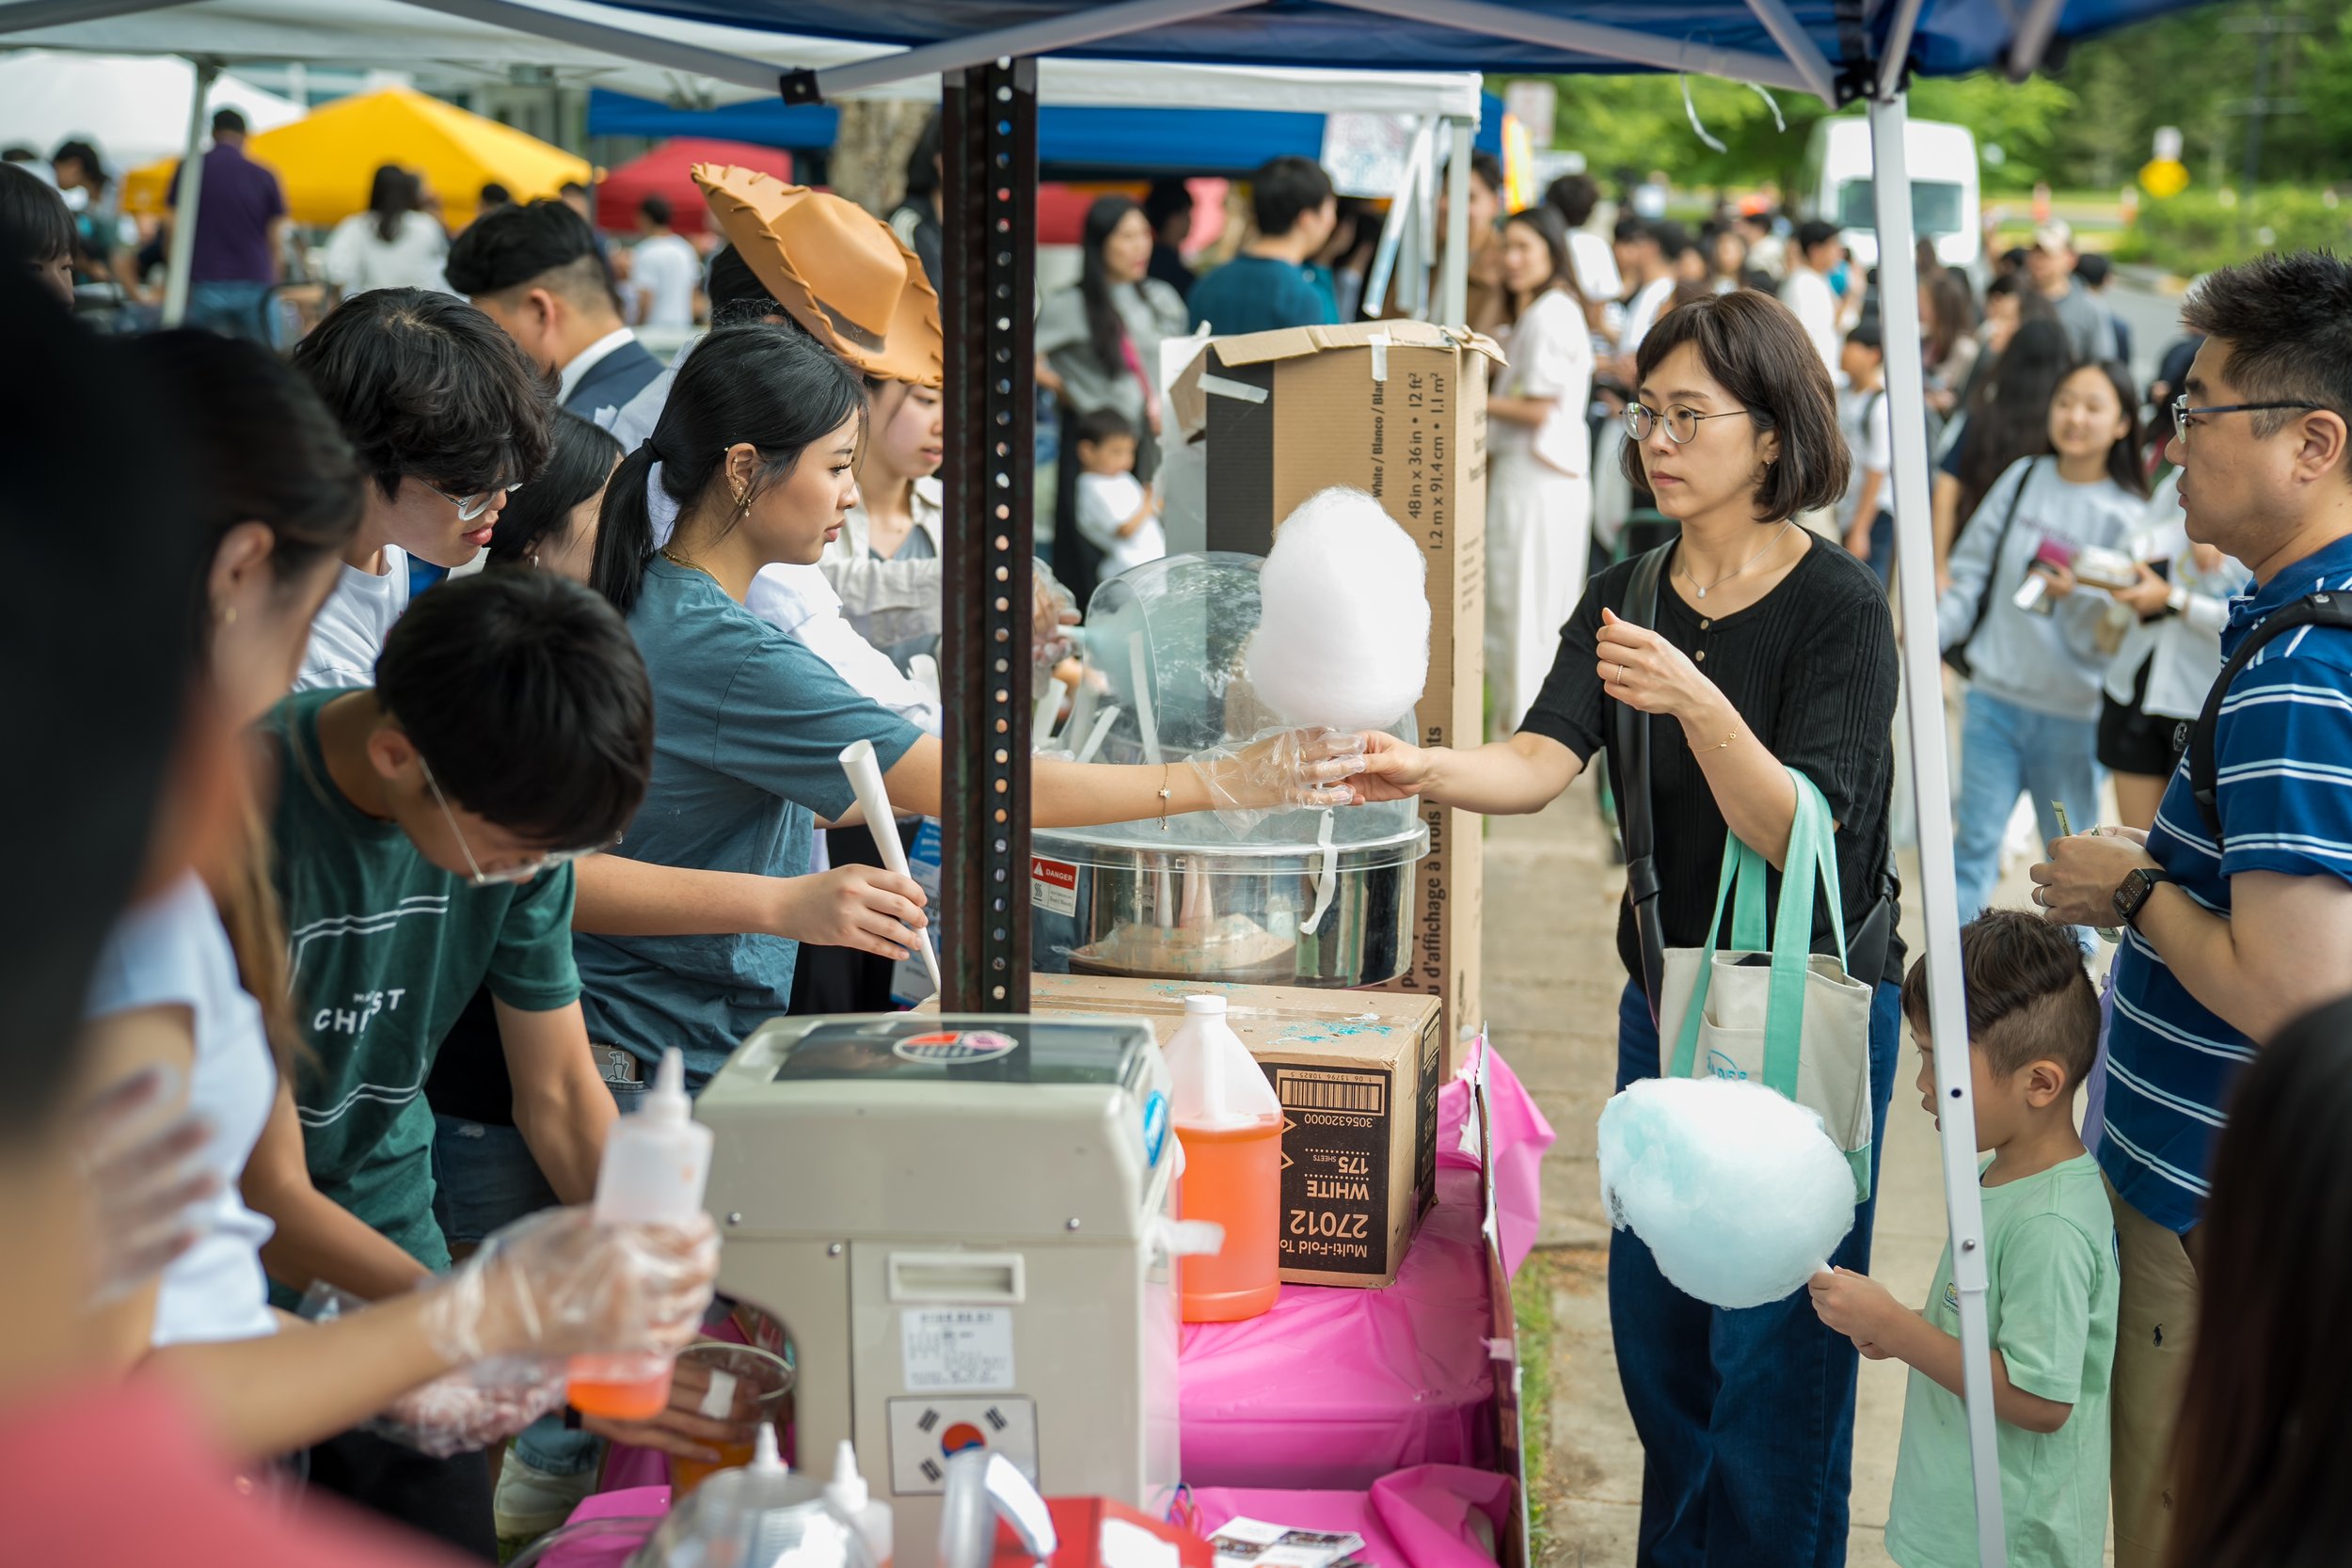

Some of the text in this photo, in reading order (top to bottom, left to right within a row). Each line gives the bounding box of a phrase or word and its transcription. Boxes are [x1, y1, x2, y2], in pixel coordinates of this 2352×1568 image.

[1372, 381, 1384, 405] Blan
[1408, 392, 1422, 407] 12
[1430, 398, 1445, 413] 1.1
[1372, 416, 1384, 455] Blanco
[1409, 431, 1422, 444] in
[1408, 447, 1422, 466] 36
[1434, 436, 1444, 460] cm
[1371, 467, 1384, 498] White
[1412, 470, 1422, 480] x
[1430, 463, 1444, 492] 91.4
[1409, 483, 1422, 498] in
[1408, 499, 1422, 519] 48
[1433, 497, 1444, 506] x
[1433, 510, 1444, 526] m
[1430, 530, 1444, 549] 1.2
[1427, 811, 1441, 854] trois
[1045, 868, 1073, 882] DANGER
[1423, 861, 1441, 872] à
[1422, 878, 1446, 978] d'affichage
[1299, 1070, 1322, 1080] 10825
[1327, 1072, 1349, 1082] 13796
[1304, 1113, 1374, 1129] 3056320000
[1312, 1153, 1370, 1175] 175 SHEETS
[1306, 1180, 1370, 1201] WHITE
[1290, 1209, 1370, 1239] 27012
[1279, 1239, 1368, 1259] Multi-Fold To
